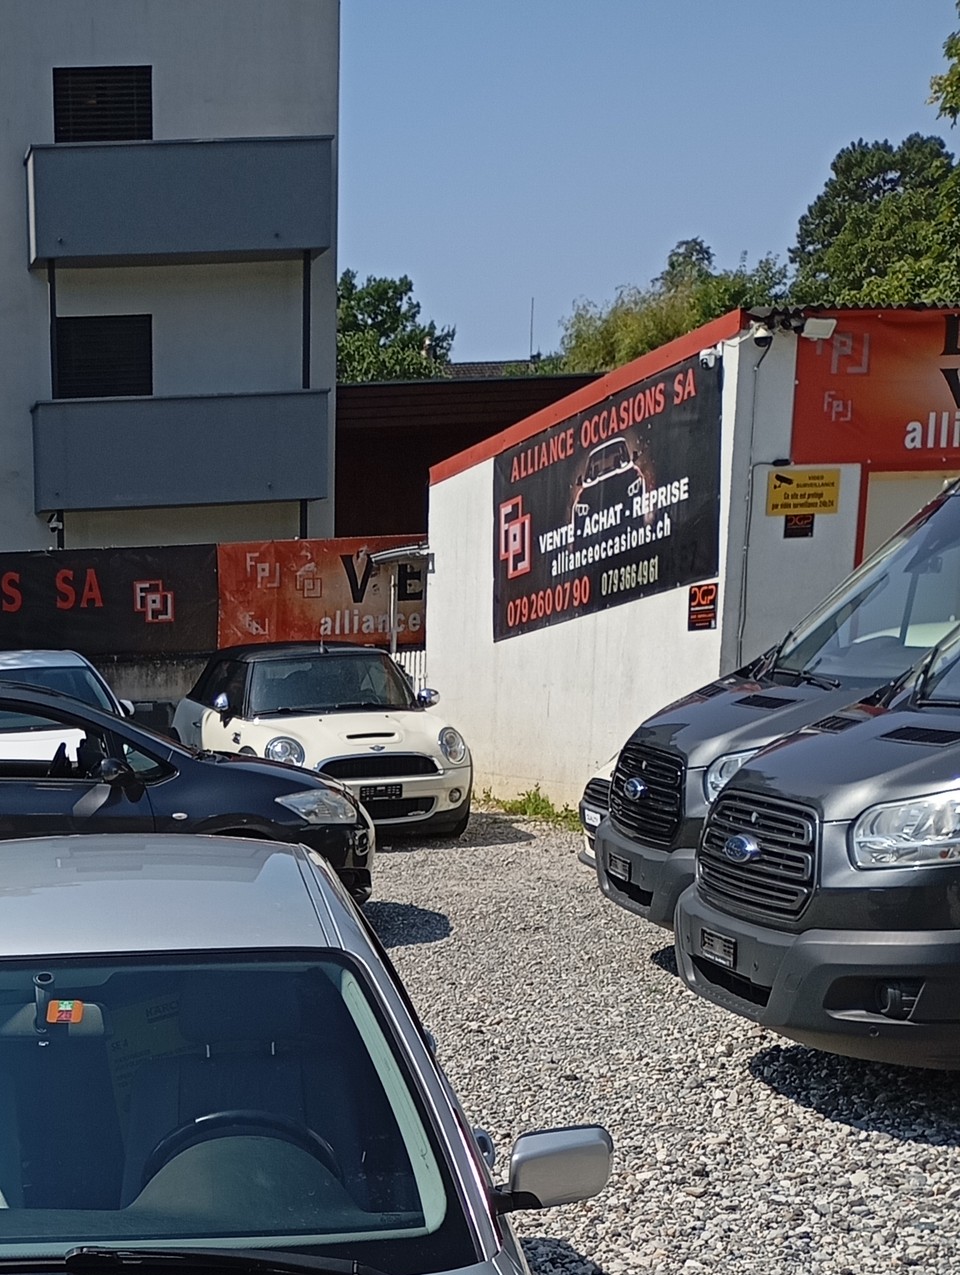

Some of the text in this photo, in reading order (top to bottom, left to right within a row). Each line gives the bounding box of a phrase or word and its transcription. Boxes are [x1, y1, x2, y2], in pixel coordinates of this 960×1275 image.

[510, 368, 696, 483] ALLIANCE OCCASIONS SA
[539, 523, 575, 554] VENTE
[583, 503, 623, 538] ACHAT
[633, 477, 689, 518] REPRISE
[551, 512, 671, 577] allianceoccasions.ch
[55, 568, 103, 610] SA
[507, 596, 528, 627] 079
[530, 588, 552, 620] 260
[320, 610, 421, 635] alliance
